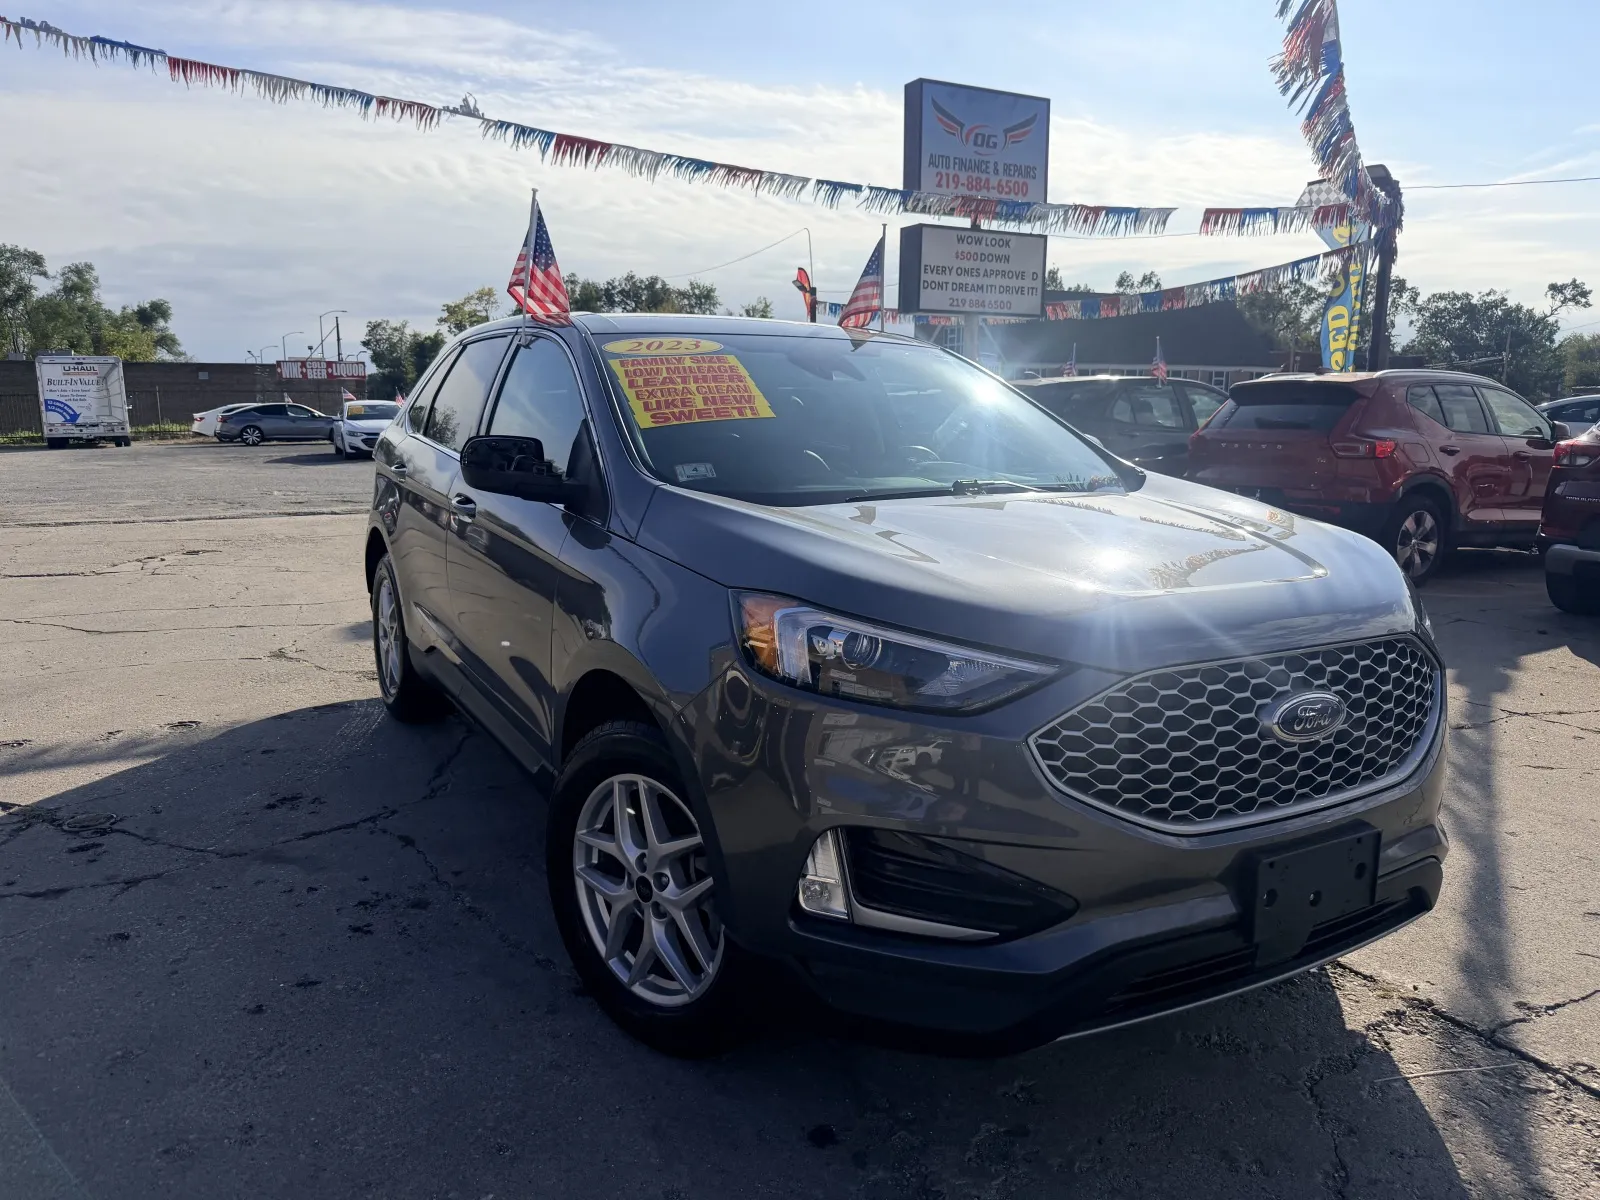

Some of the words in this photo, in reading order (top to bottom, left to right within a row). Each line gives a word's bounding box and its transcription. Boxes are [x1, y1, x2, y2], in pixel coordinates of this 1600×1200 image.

[973, 132, 998, 149] OG
[928, 153, 951, 170] AUTO
[953, 156, 991, 174] FINANCE
[993, 161, 999, 176] &
[1003, 162, 1037, 180] REPAIRS
[935, 171, 1029, 197] 219-884-6500
[956, 234, 984, 247] WOW
[985, 237, 1011, 249] LOOK
[955, 250, 979, 262] $500
[980, 252, 1010, 264] DOWN
[923, 264, 954, 277] EVERY
[955, 266, 981, 278] ONES
[922, 279, 950, 292] DONT
[951, 281, 984, 294] DREAM
[985, 284, 997, 294] IT!
[998, 285, 1025, 296] DRIVE
[1027, 286, 1038, 297] IT!
[949, 297, 967, 308] 219
[968, 298, 986, 309] 884
[988, 299, 1012, 311] 6500
[626, 339, 702, 352] 2023
[619, 356, 686, 369] FAMILY
[689, 354, 730, 365] SIZE
[280, 361, 303, 379] WINE
[306, 361, 327, 369] COLD
[307, 368, 328, 379] BEER
[332, 363, 365, 377] LIQUOR
[624, 366, 664, 378] LOW
[665, 363, 741, 376] MILEAGE
[627, 374, 747, 390] LEATHER
[634, 385, 697, 401] EXTRA
[696, 383, 753, 396] CLEAN
[642, 396, 698, 412] LIKE
[702, 394, 756, 407] NEW
[649, 406, 761, 425] SWEET!
[1293, 704, 1333, 731] Ford
